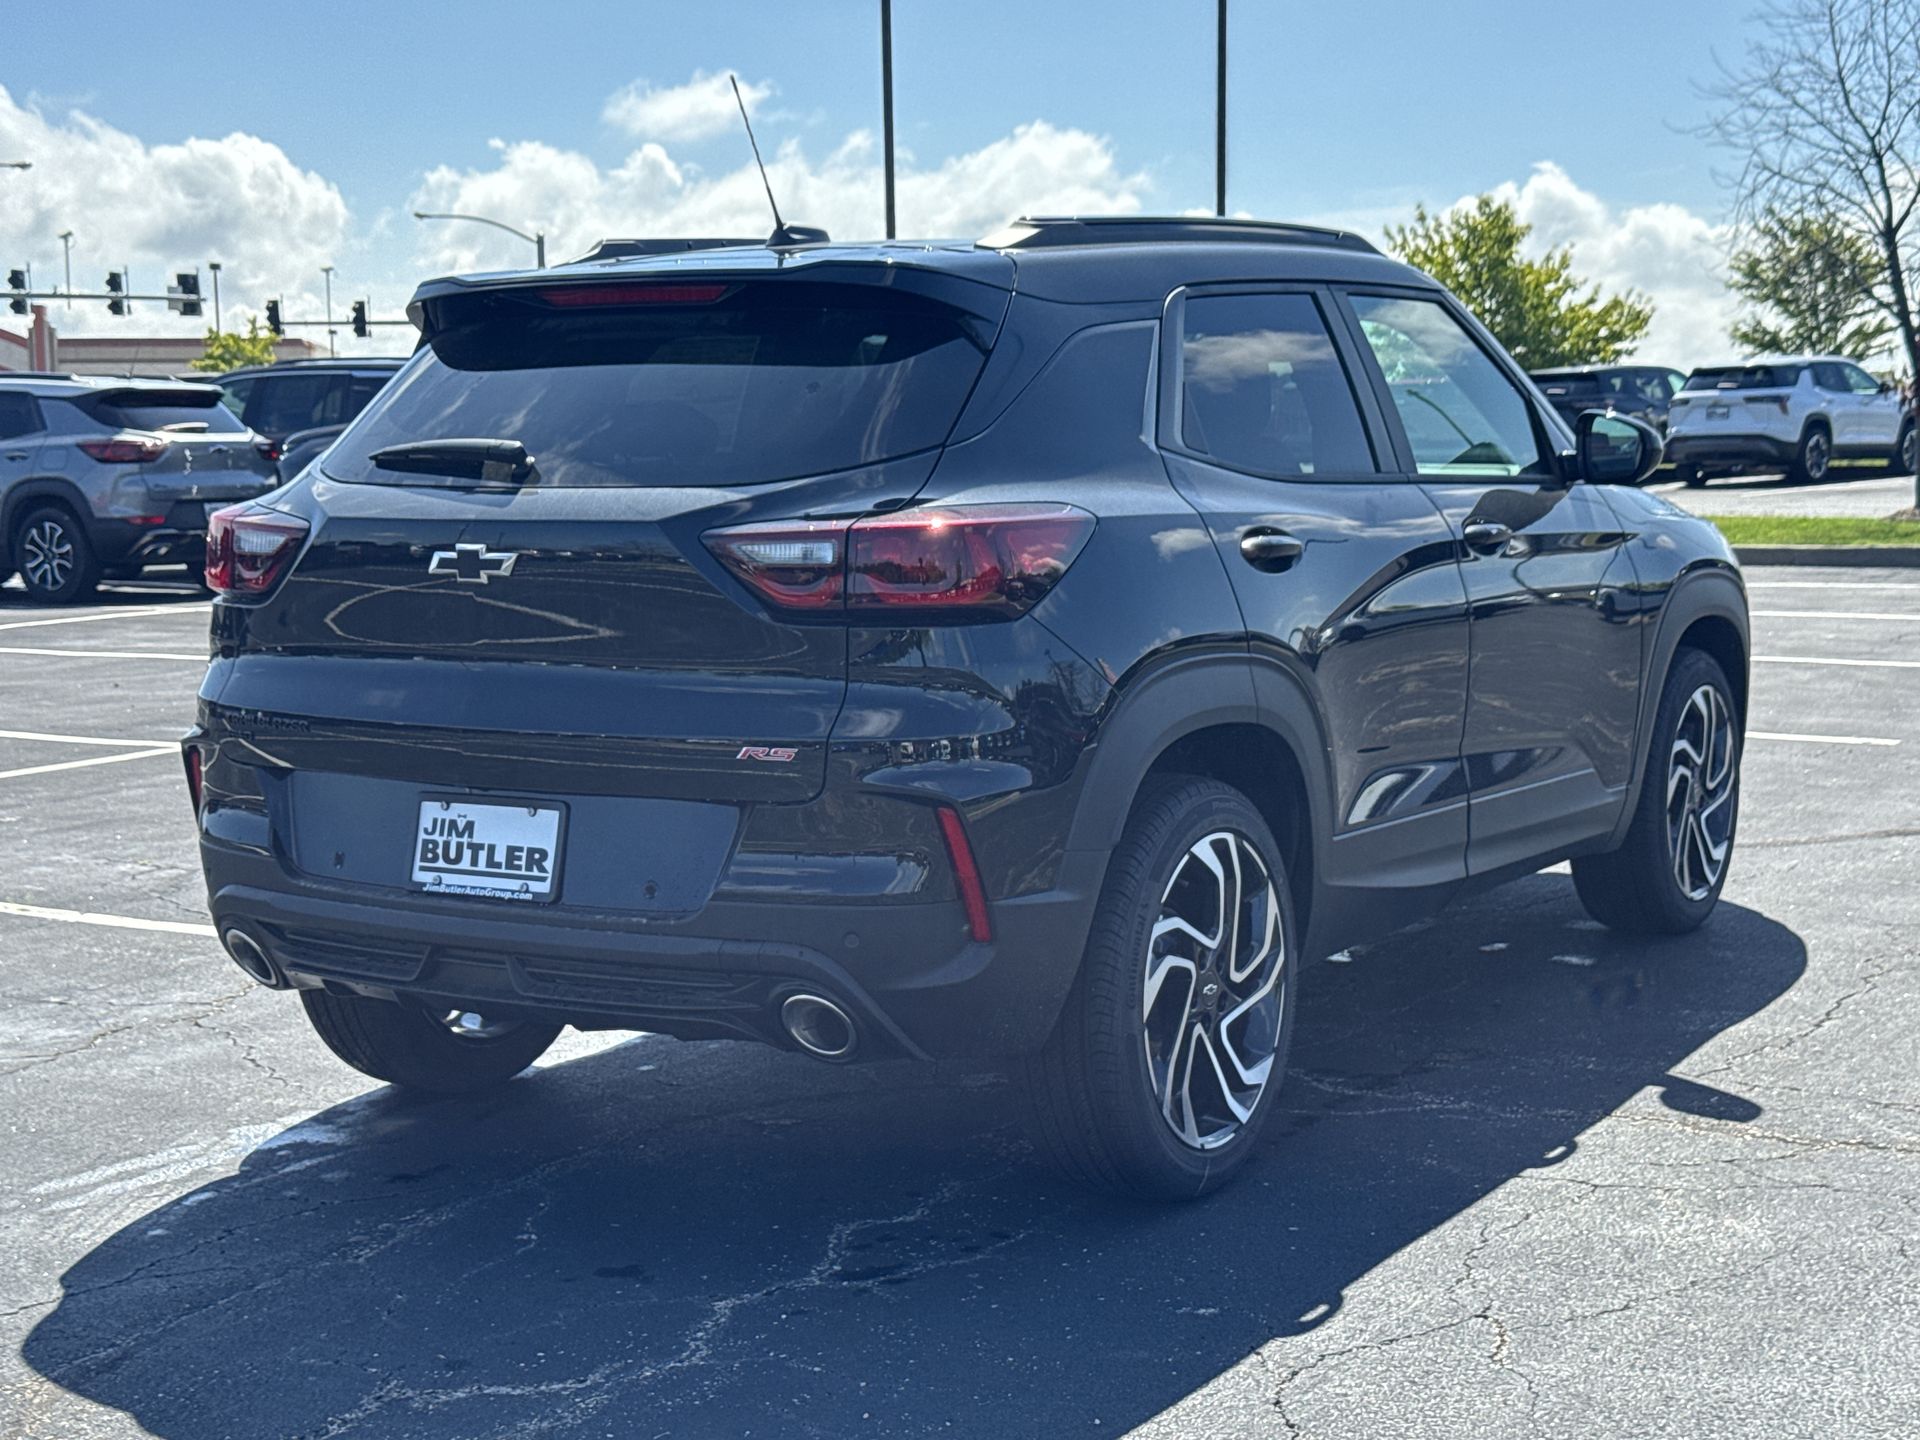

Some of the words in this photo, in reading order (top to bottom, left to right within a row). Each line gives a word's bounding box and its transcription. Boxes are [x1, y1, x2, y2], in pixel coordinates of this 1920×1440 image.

[736, 746, 799, 761] RS
[423, 817, 475, 839] JIM
[419, 838, 550, 874] BUTLER
[422, 884, 533, 900] JimButlerAutoGroup.com
